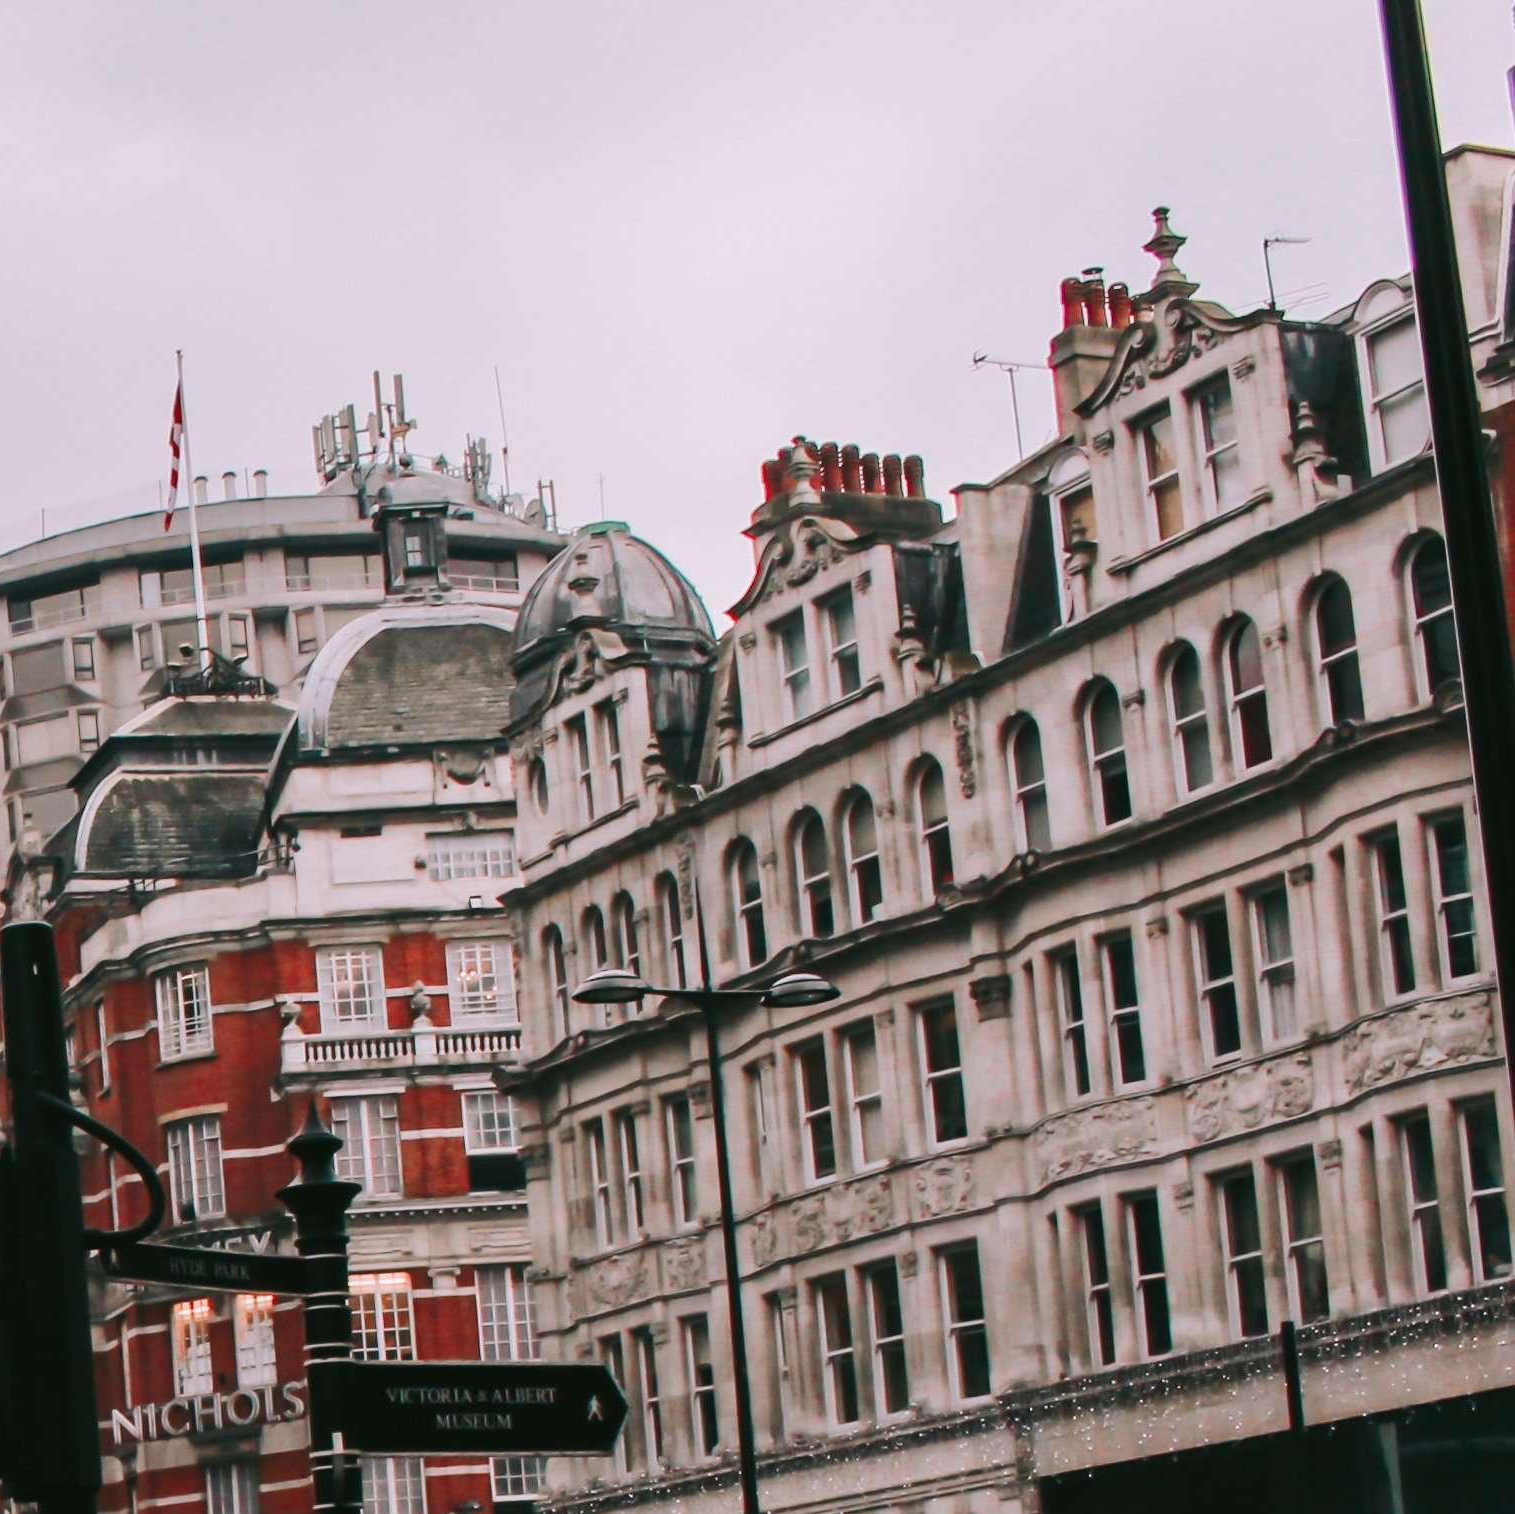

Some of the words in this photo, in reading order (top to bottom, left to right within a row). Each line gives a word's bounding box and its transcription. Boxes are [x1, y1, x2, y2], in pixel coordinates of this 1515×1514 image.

[170, 1258, 207, 1276] HYDE
[214, 1261, 251, 1281] PARK
[386, 1387, 471, 1404] VICTORIA
[493, 1387, 557, 1404] ALBERT
[111, 1381, 305, 1446] NICHOLS
[435, 1413, 513, 1430] MUSEUM
